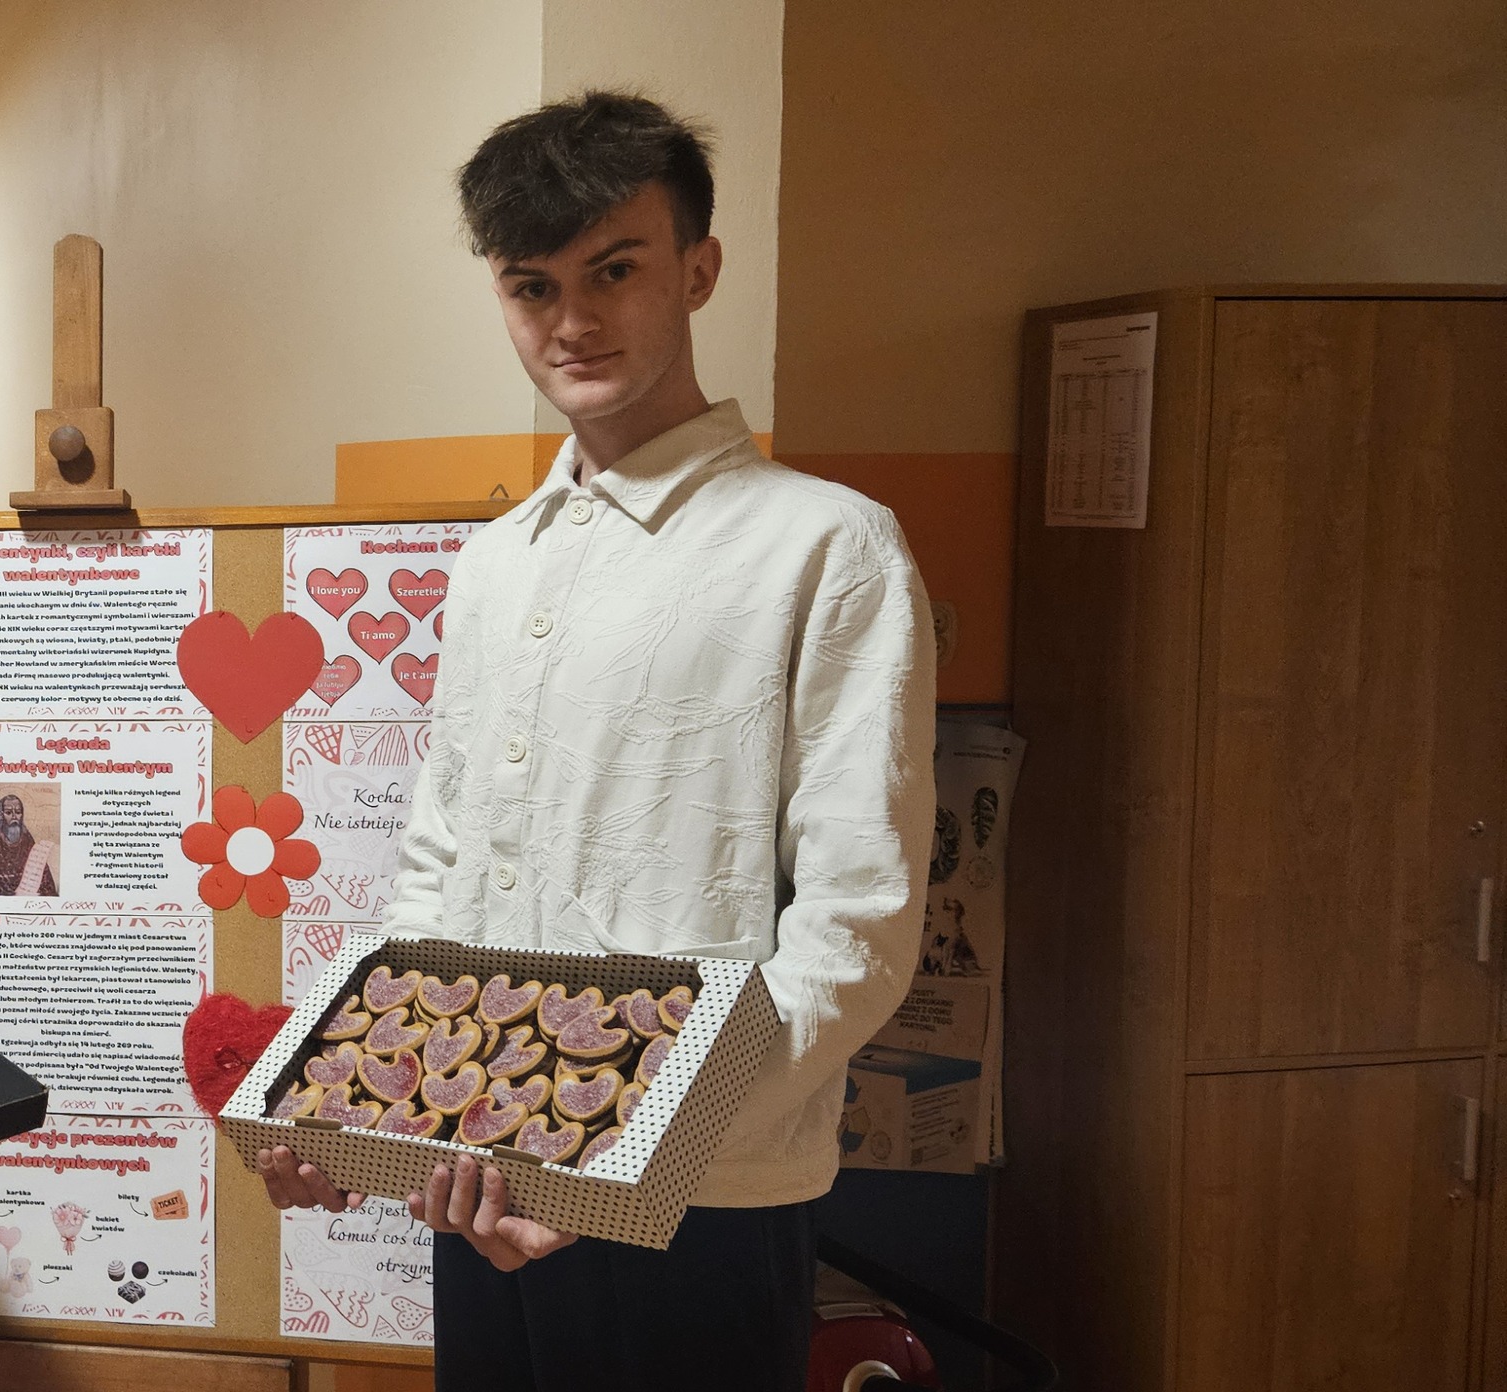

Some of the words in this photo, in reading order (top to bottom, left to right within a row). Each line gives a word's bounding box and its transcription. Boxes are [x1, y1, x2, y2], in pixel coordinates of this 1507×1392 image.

[76, 543, 118, 562] czyli
[121, 542, 181, 556] kartki
[361, 540, 438, 554] Kocham
[441, 538, 466, 552] Ci
[3, 568, 140, 585] walentynkowe
[317, 586, 338, 594] love
[341, 588, 360, 597] you
[360, 631, 370, 640] Ti
[372, 632, 396, 640] amo
[399, 672, 410, 681] Je
[36, 737, 110, 754] Legenda
[76, 760, 173, 778] Walentym
[354, 782, 406, 808] Kocha
[314, 813, 344, 829] Nie
[348, 815, 406, 838] istnieje
[70, 1133, 177, 1148] prezentów
[118, 1194, 139, 1202] bilety
[158, 1196, 178, 1208] TICKET
[376, 1203, 409, 1225] jest
[328, 1218, 377, 1241] komuś
[383, 1230, 407, 1245] coś
[413, 1226, 434, 1246] da
